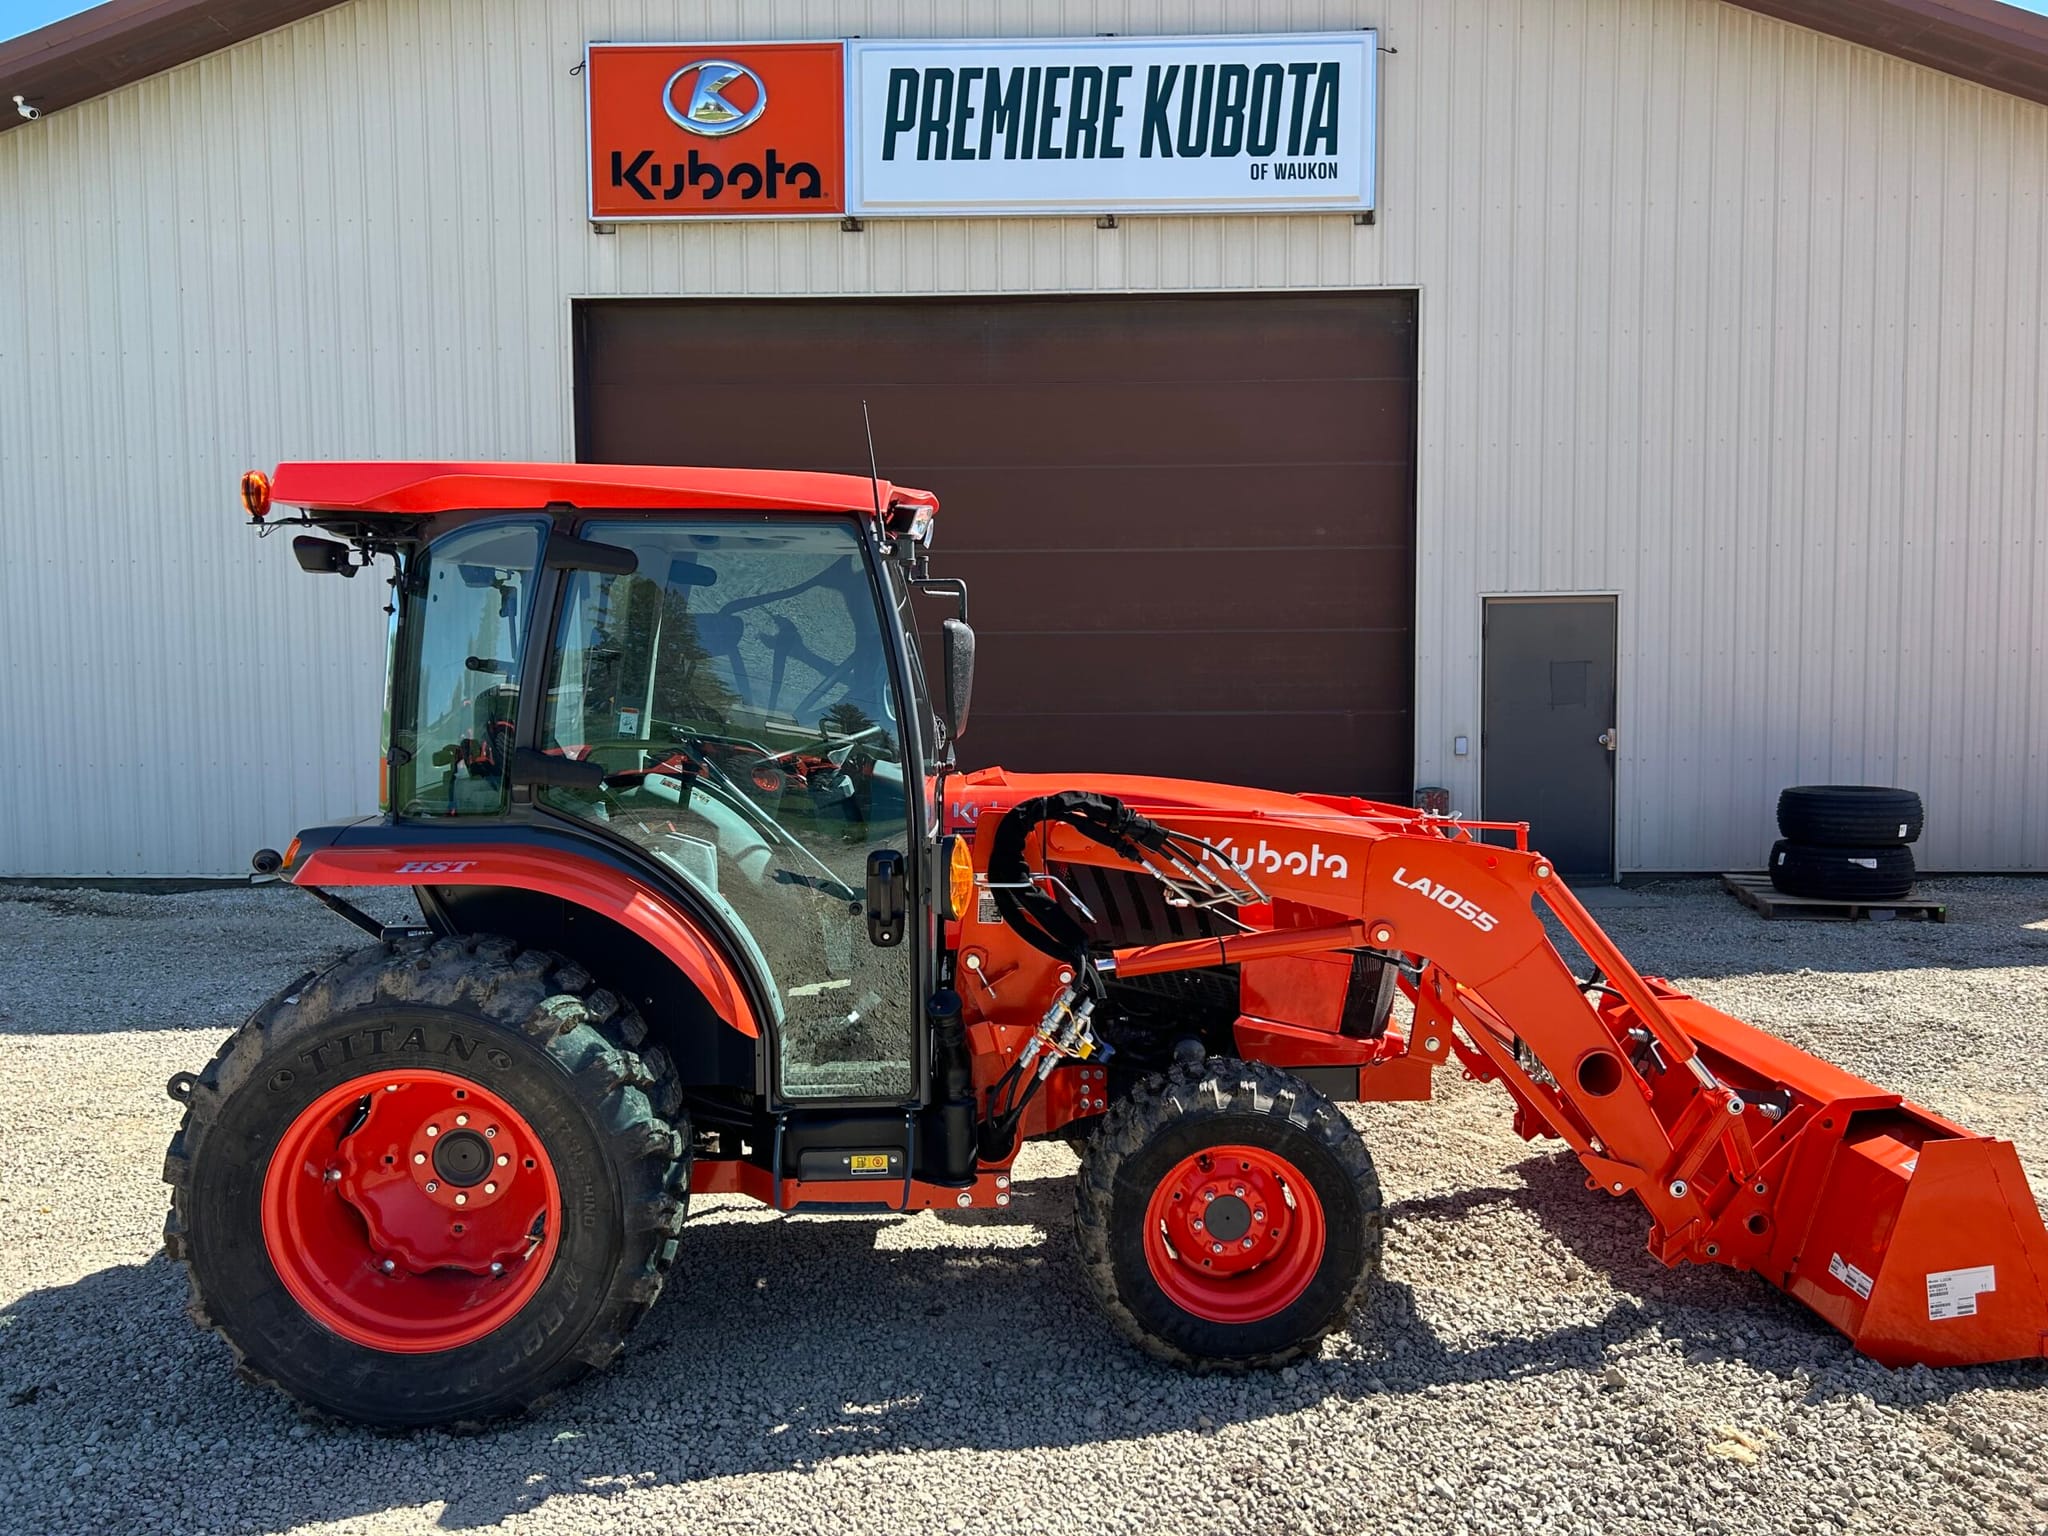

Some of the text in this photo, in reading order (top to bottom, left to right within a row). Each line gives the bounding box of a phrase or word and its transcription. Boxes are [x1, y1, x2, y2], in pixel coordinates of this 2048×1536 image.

[882, 62, 1340, 160] PREMIERE KUBOTA
[611, 149, 822, 200] Kubota
[1249, 162, 1338, 181] OF WAUKON
[394, 861, 479, 874] HST
[1202, 836, 1348, 879] Kubota
[1392, 866, 1499, 932] LA1055
[300, 1023, 487, 1076] TITAN
